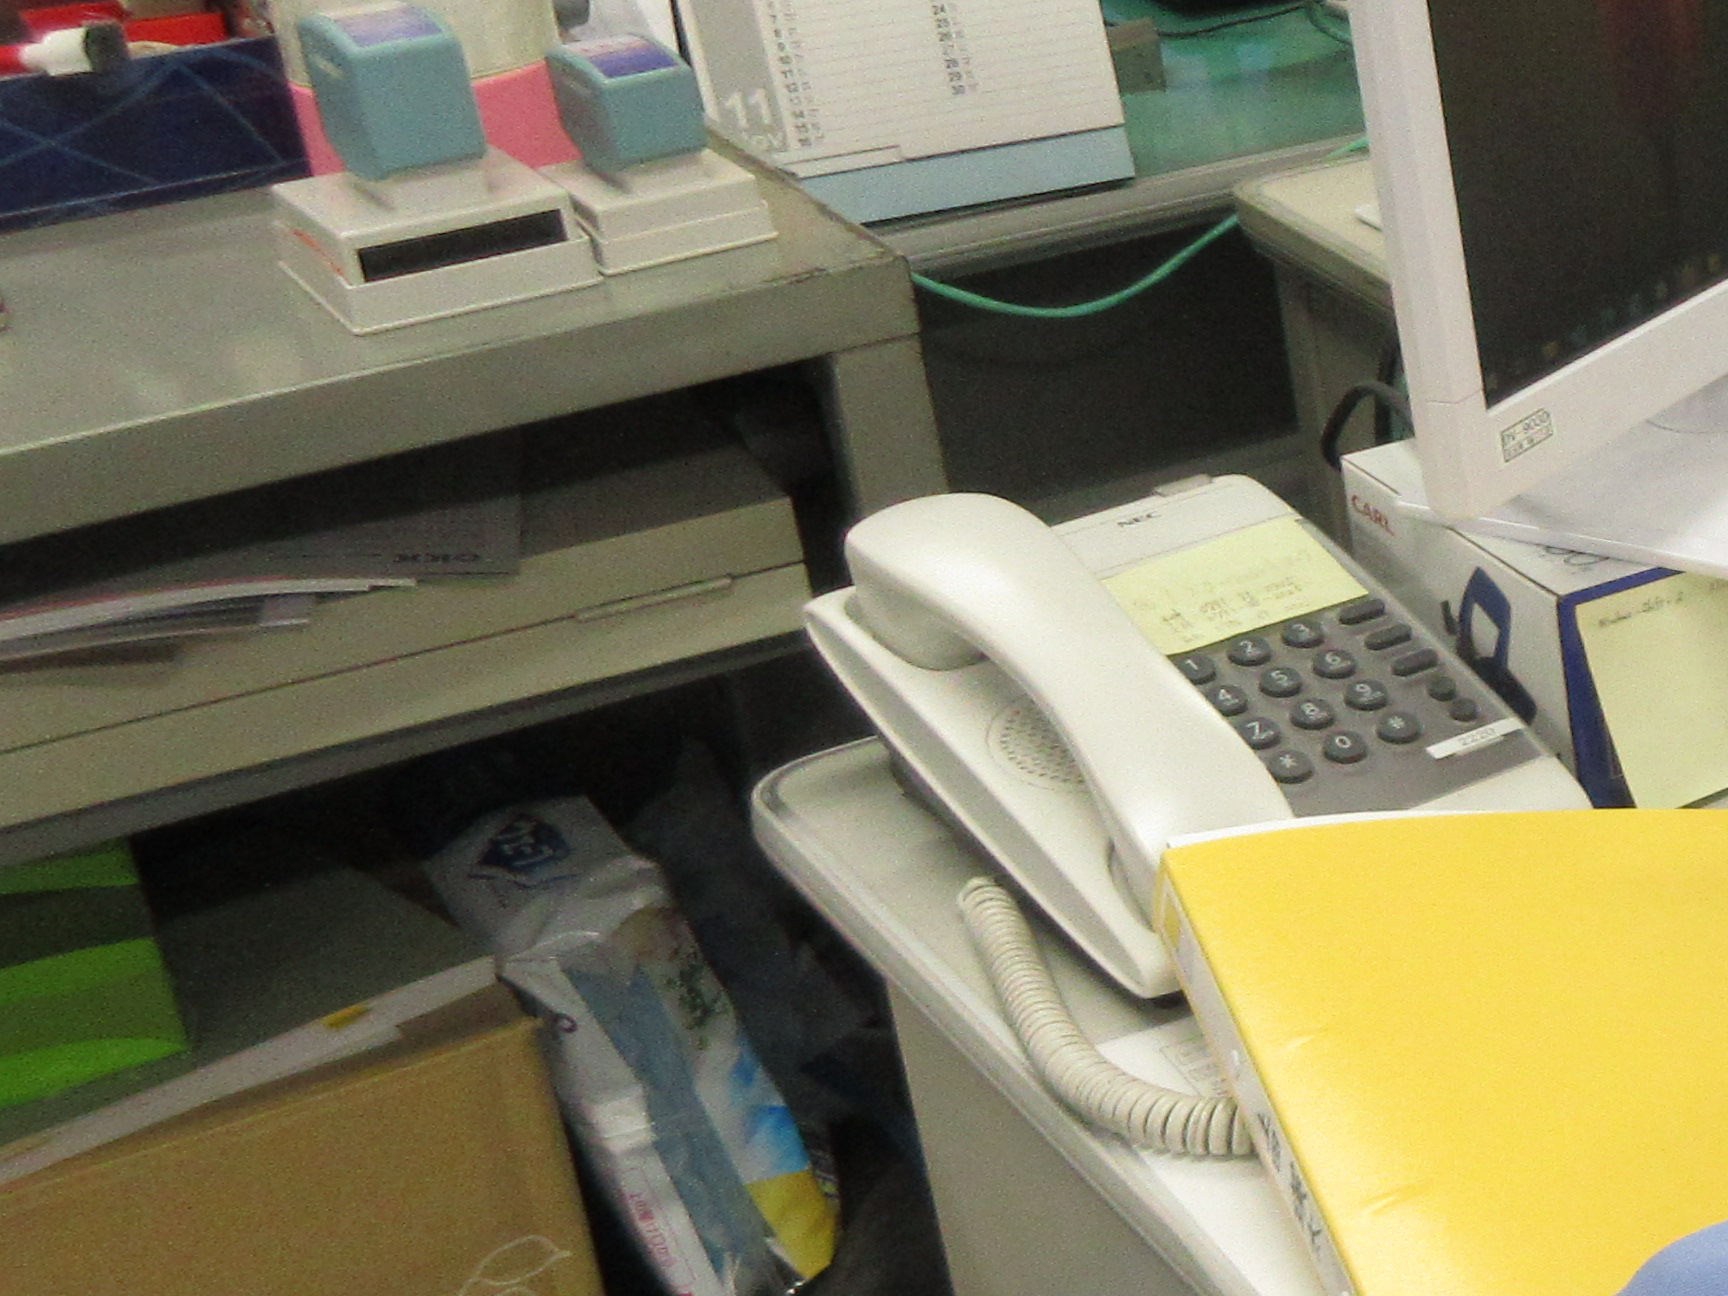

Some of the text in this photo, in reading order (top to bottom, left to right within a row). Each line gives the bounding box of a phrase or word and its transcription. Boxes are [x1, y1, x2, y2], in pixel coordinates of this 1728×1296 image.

[725, 88, 772, 128] 11
[1116, 510, 1161, 527] NEC
[1217, 652, 1341, 701] 4 5 6
[1335, 736, 1351, 748] 0
[1457, 727, 1495, 746] 2220
